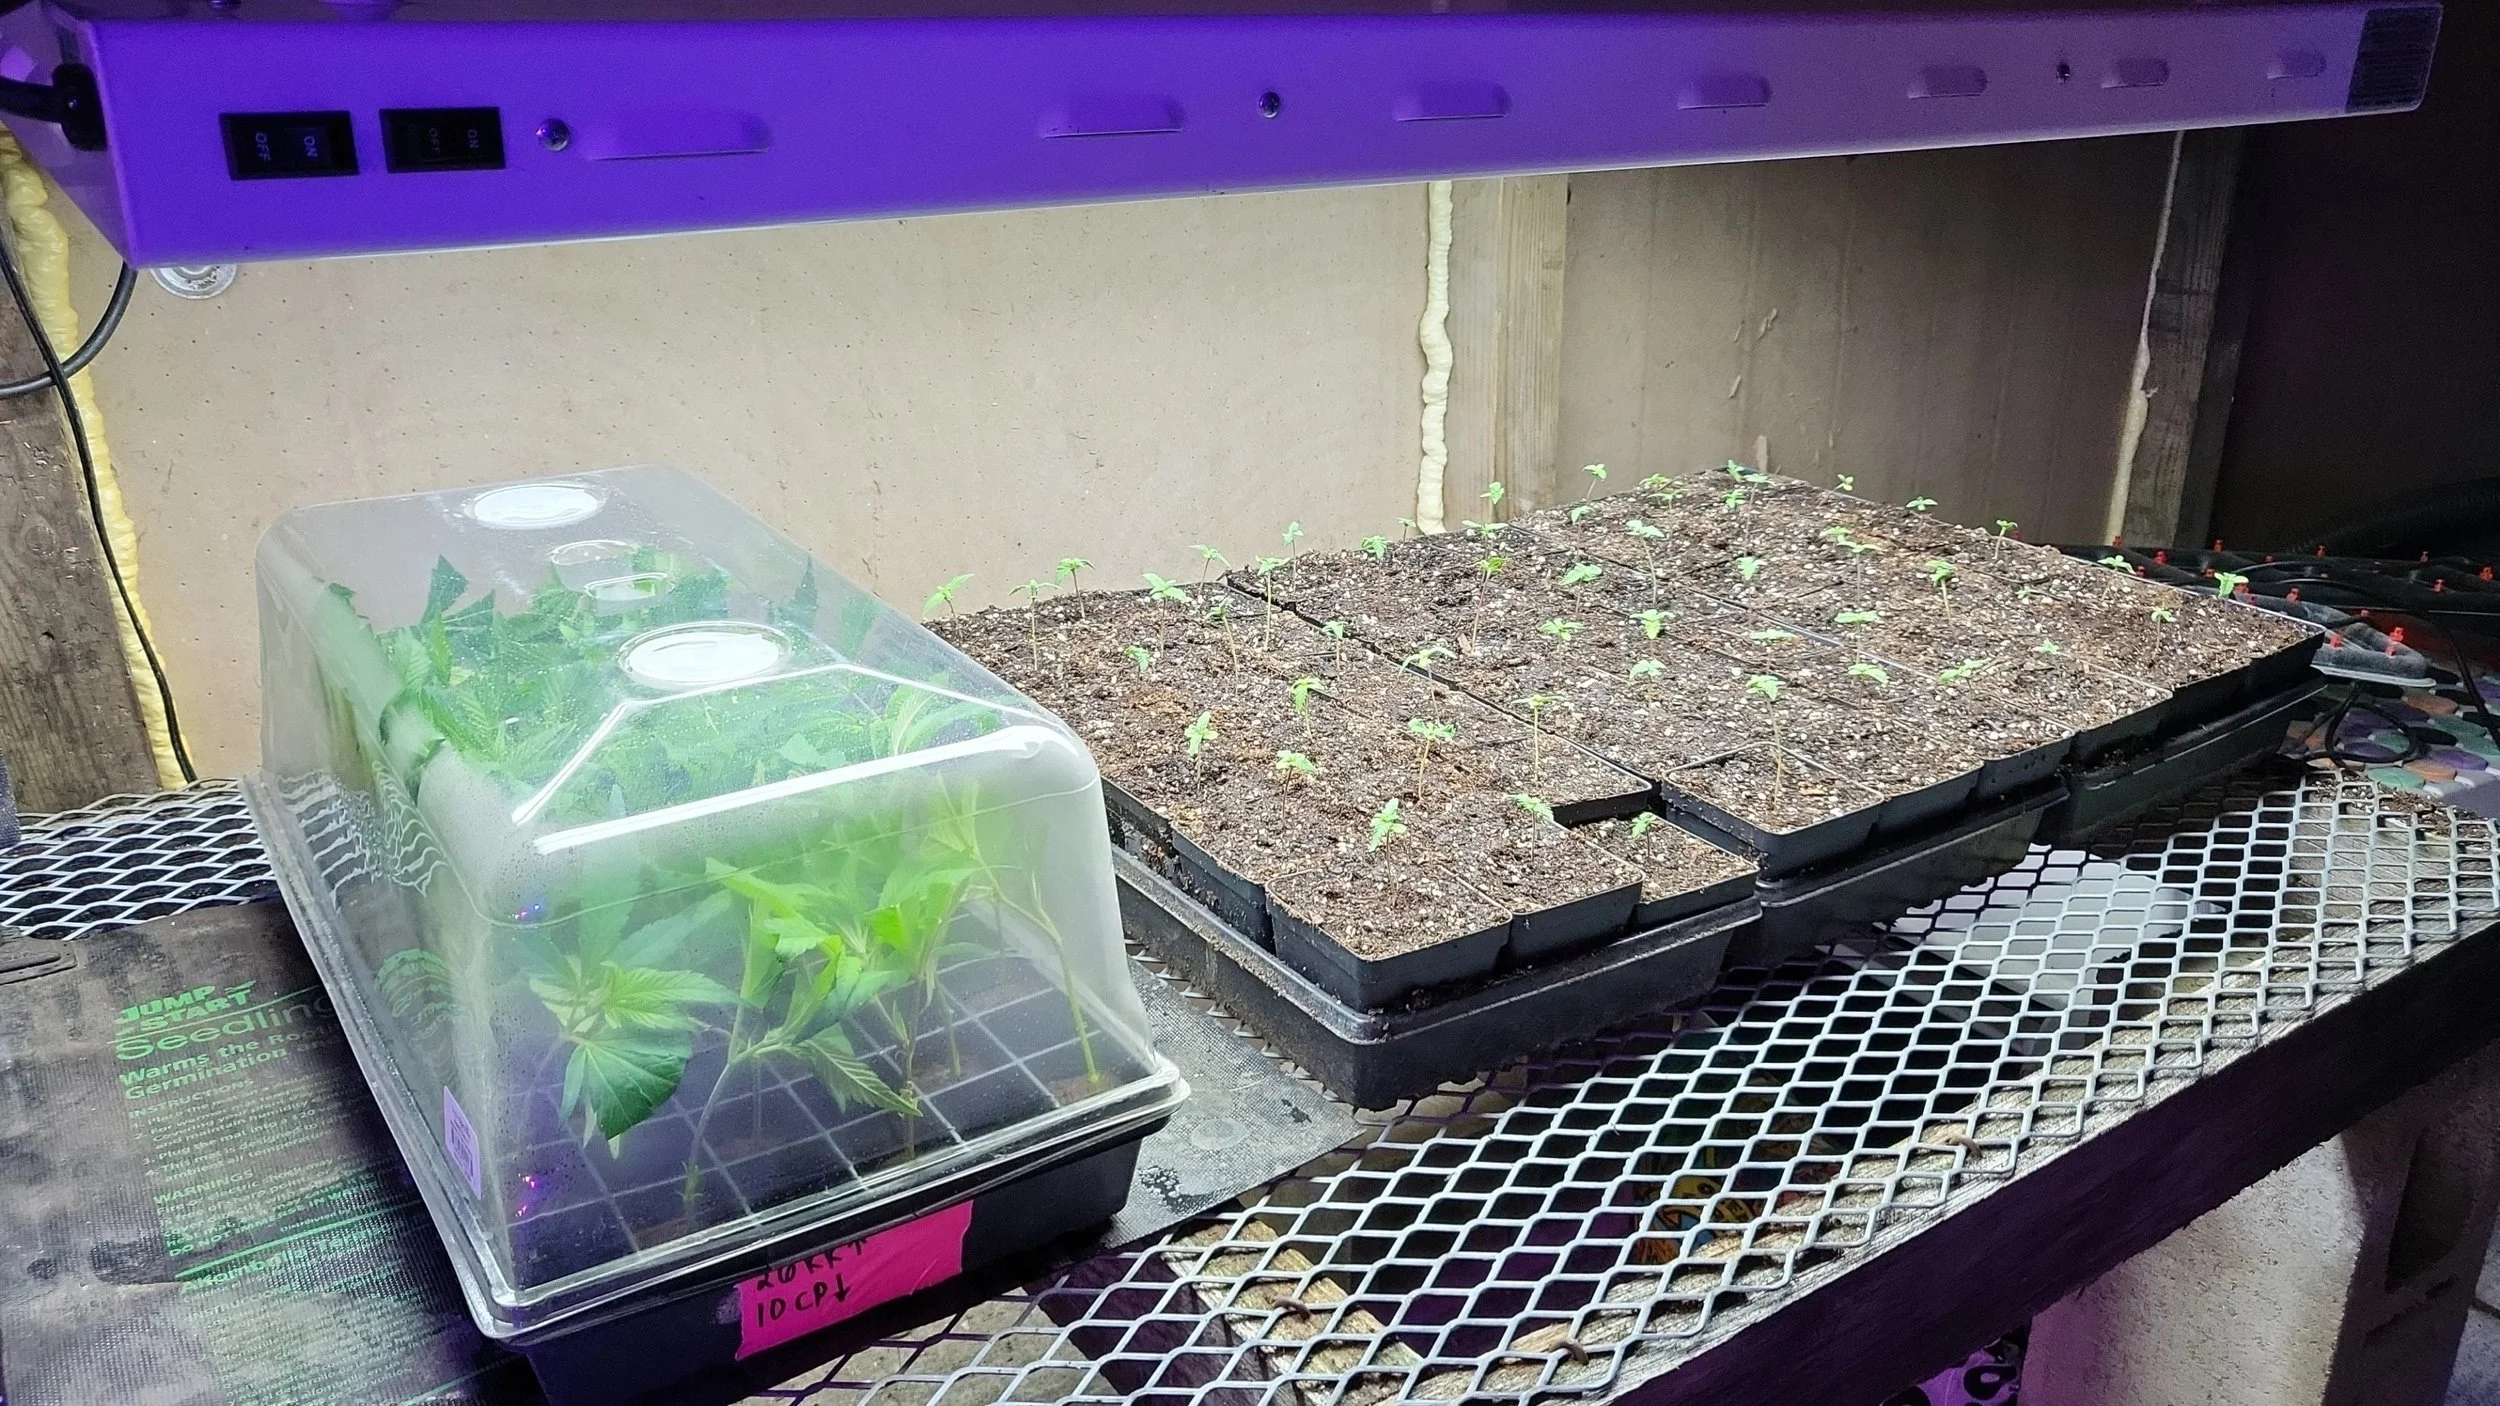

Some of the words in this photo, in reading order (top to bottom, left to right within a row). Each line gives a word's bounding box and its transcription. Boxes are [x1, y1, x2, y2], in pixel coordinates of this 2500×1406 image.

[255, 131, 273, 163] OFF
[303, 135, 319, 159] ON
[428, 127, 442, 155] OFF
[467, 128, 480, 150] ON
[116, 985, 216, 1024] JUMP
[140, 989, 251, 1031] START
[119, 1053, 210, 1086] Warms
[217, 1039, 260, 1058] the
[125, 1048, 287, 1099] Germination
[129, 1079, 254, 1119] INSTRUCTIONS
[159, 1147, 190, 1161] Plug
[153, 1168, 254, 1203] WARNINGS
[157, 1202, 185, 1216] Fire
[169, 1243, 194, 1257] DO
[198, 1230, 232, 1248] NOT
[308, 1196, 326, 1209] IN
